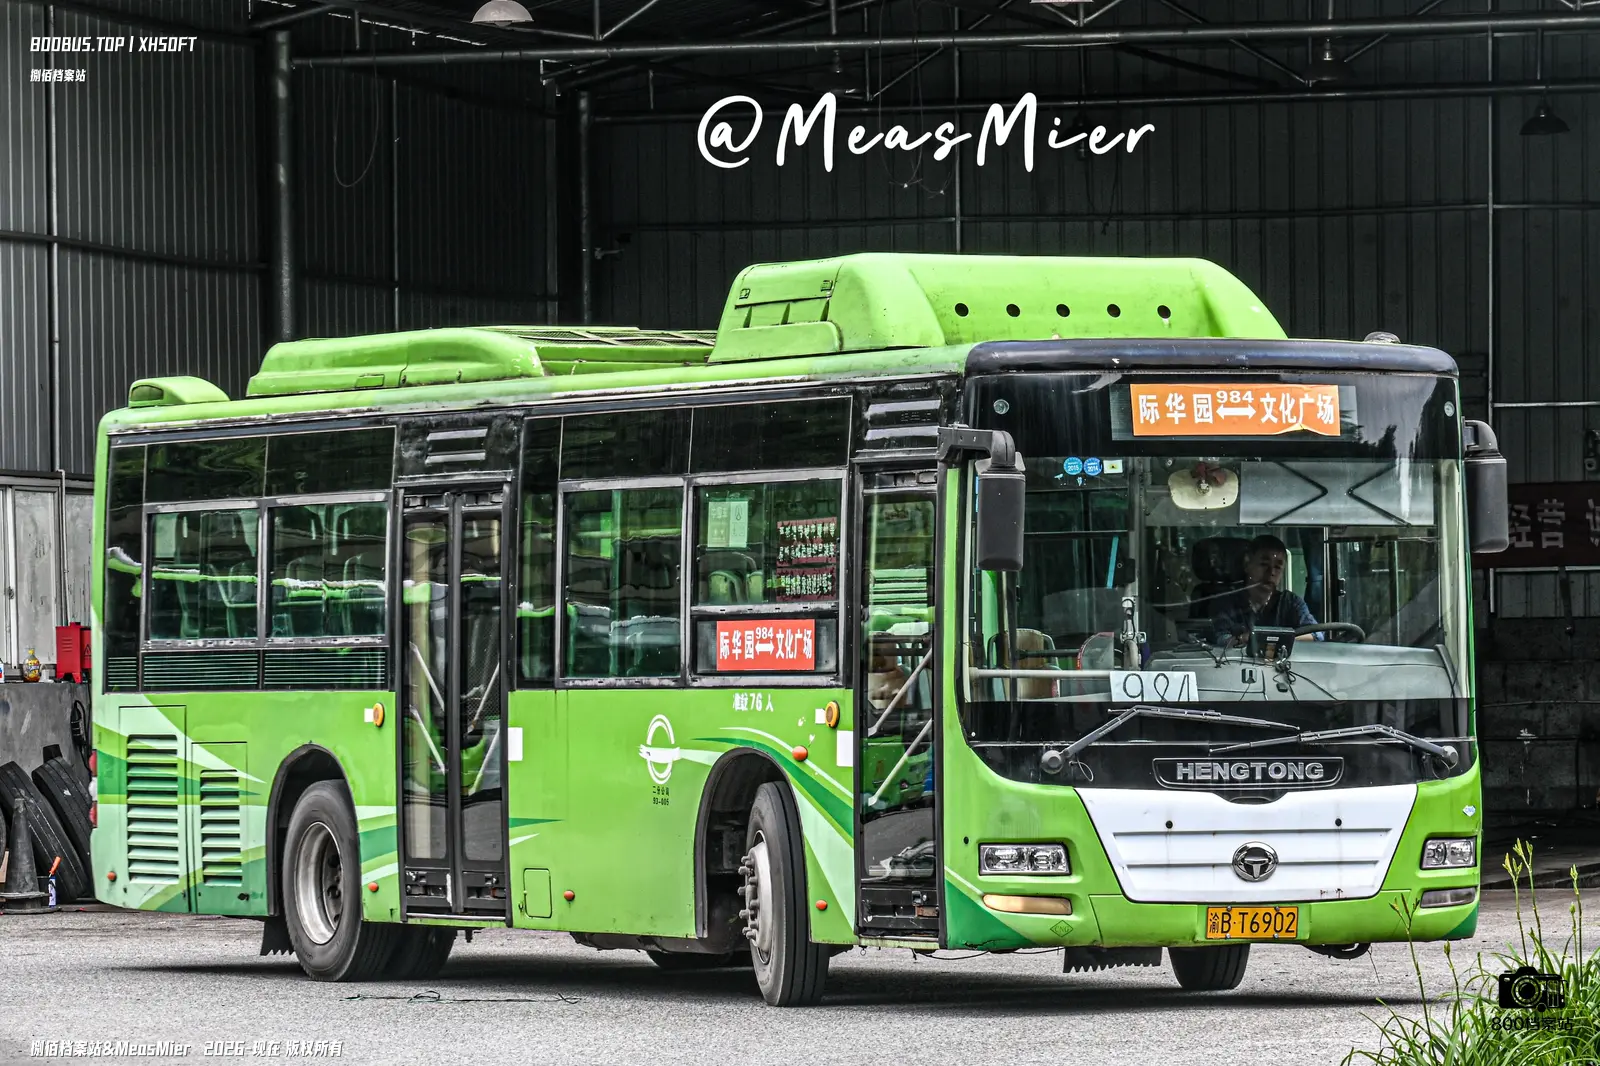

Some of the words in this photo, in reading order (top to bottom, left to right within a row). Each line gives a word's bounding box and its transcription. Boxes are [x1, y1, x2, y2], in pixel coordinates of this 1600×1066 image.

[1138, 393, 1213, 424] 际华园
[1216, 391, 1254, 403] 984
[1260, 393, 1334, 424] 文化广场
[720, 630, 754, 660] 际华园
[755, 627, 773, 639] 984
[776, 629, 812, 659] 文化广场
[1176, 762, 1324, 780] HENGTONG
